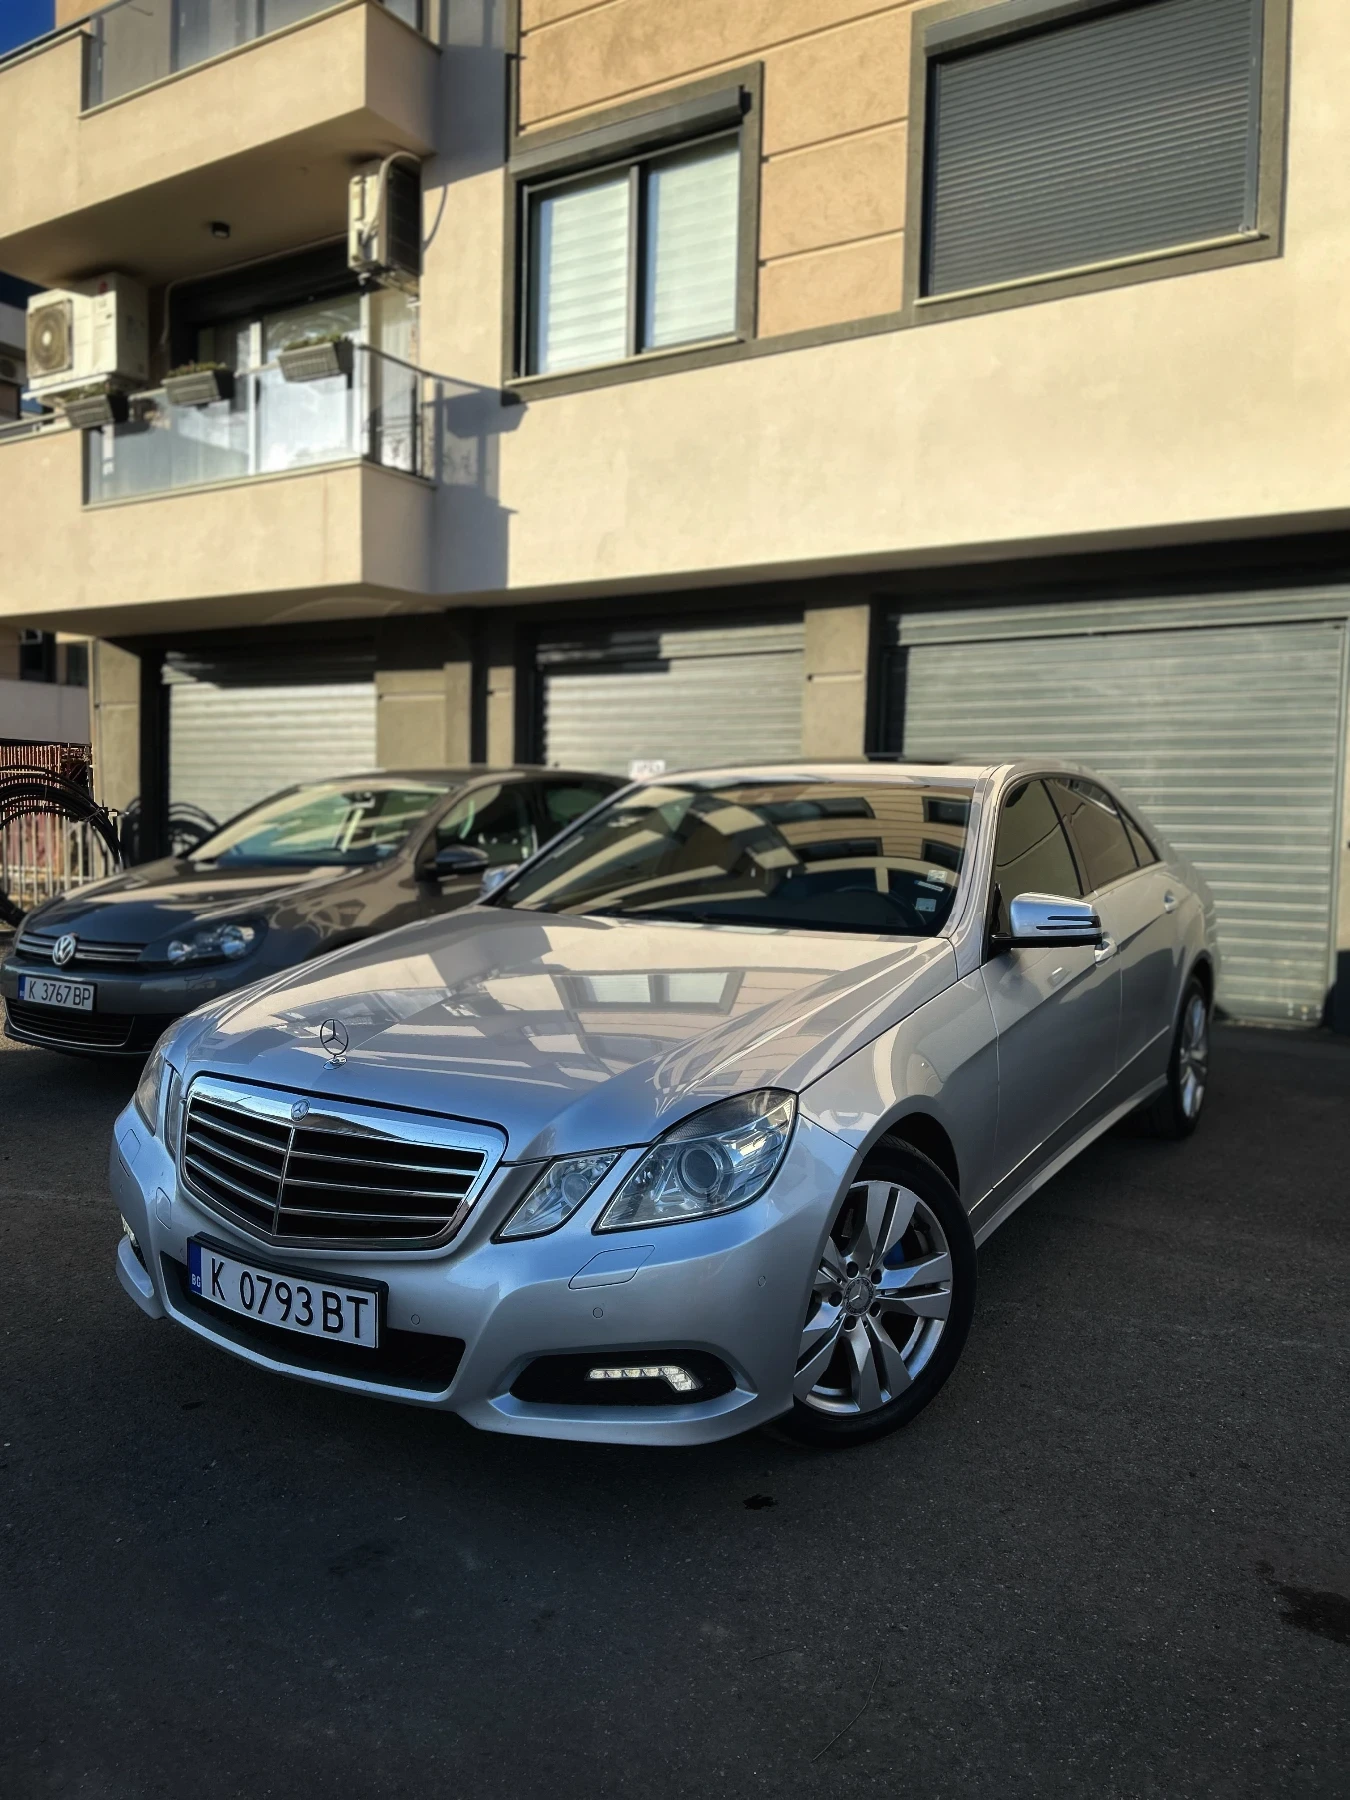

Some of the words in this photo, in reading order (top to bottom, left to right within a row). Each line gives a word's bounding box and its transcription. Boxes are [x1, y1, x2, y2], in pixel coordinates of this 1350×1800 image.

[29, 980, 36, 999] K
[191, 1273, 201, 1288] BG
[211, 1257, 226, 1301] K
